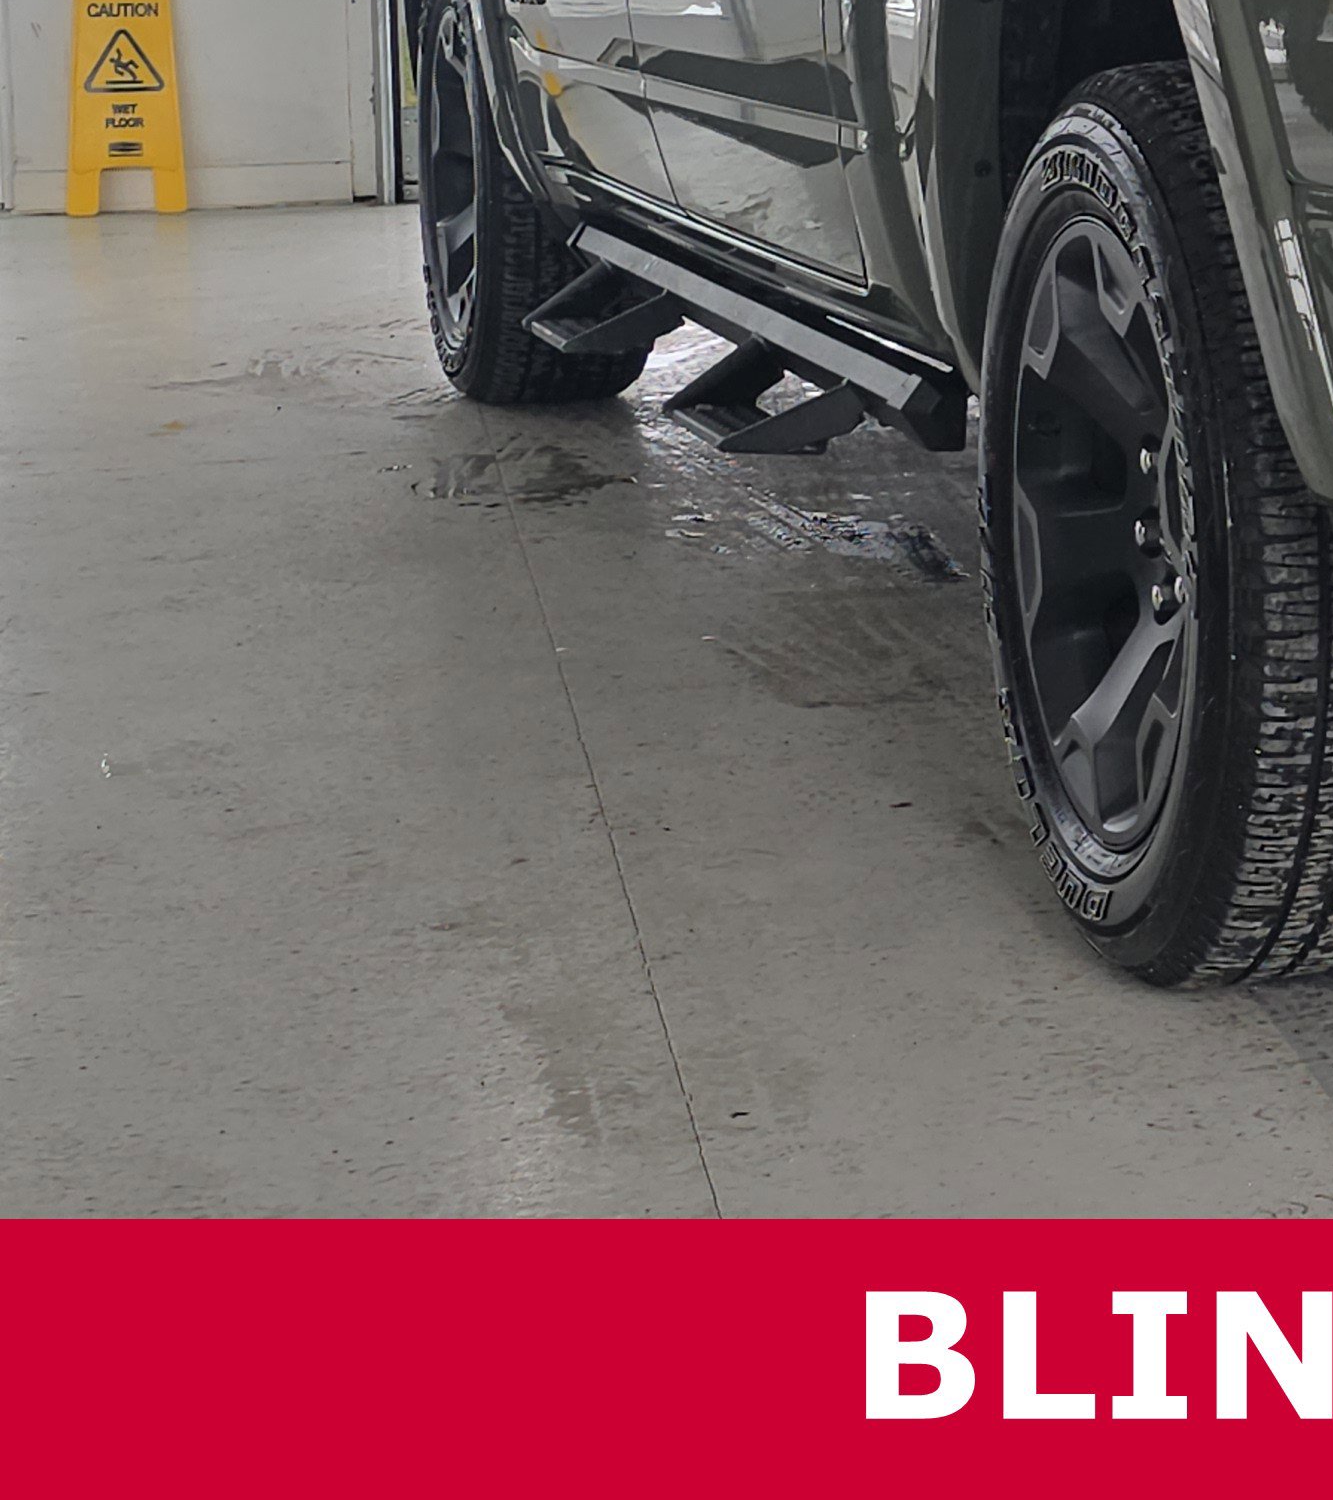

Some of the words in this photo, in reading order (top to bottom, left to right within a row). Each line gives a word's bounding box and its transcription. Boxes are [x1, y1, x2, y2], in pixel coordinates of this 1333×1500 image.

[86, 2, 159, 18] CAUTION
[111, 103, 138, 115] WET
[105, 117, 144, 129] FLOOR
